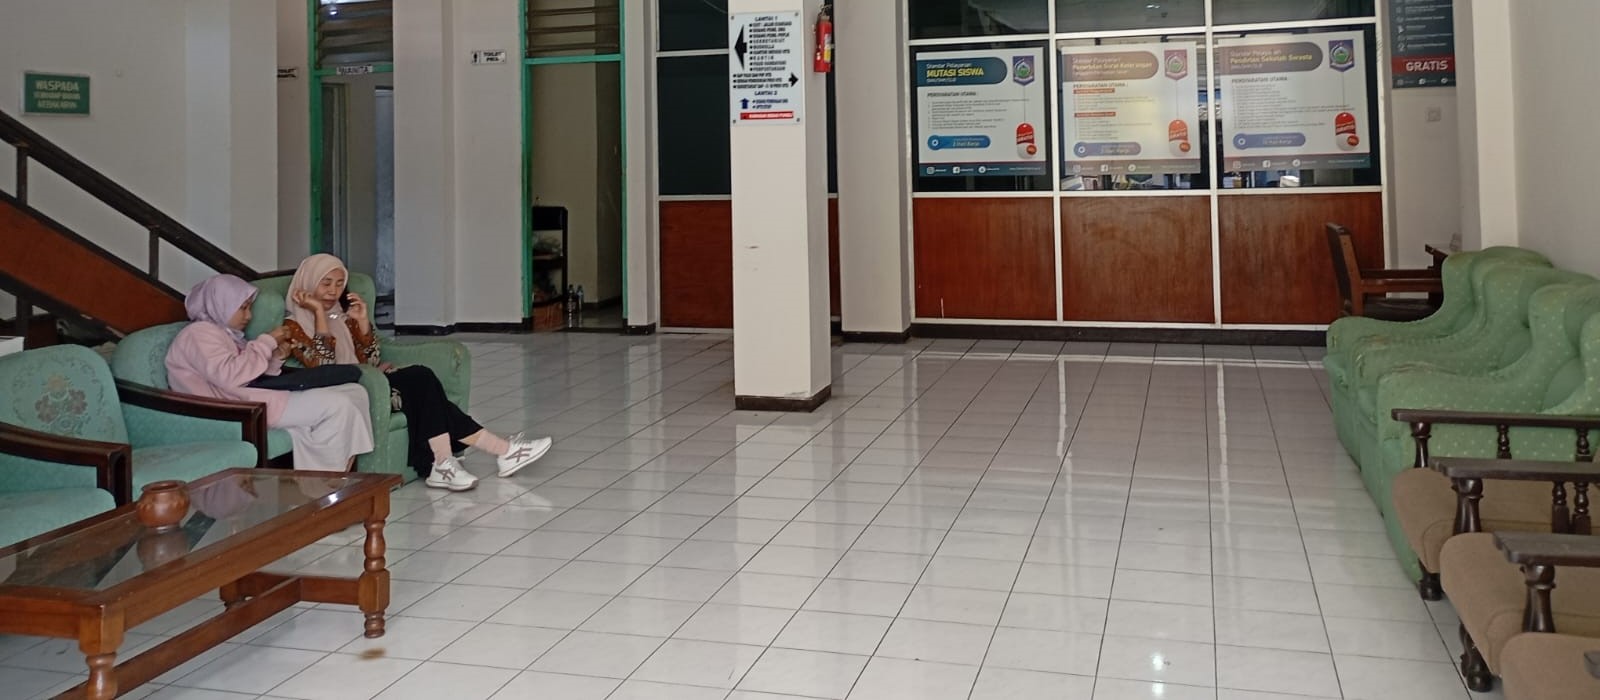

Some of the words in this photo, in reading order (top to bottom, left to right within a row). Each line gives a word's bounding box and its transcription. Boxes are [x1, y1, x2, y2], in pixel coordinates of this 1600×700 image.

[1406, 60, 1448, 71] GRATIS
[926, 68, 957, 78] MUTASI
[957, 67, 984, 76] SISWA
[35, 80, 79, 91] WASPADA
